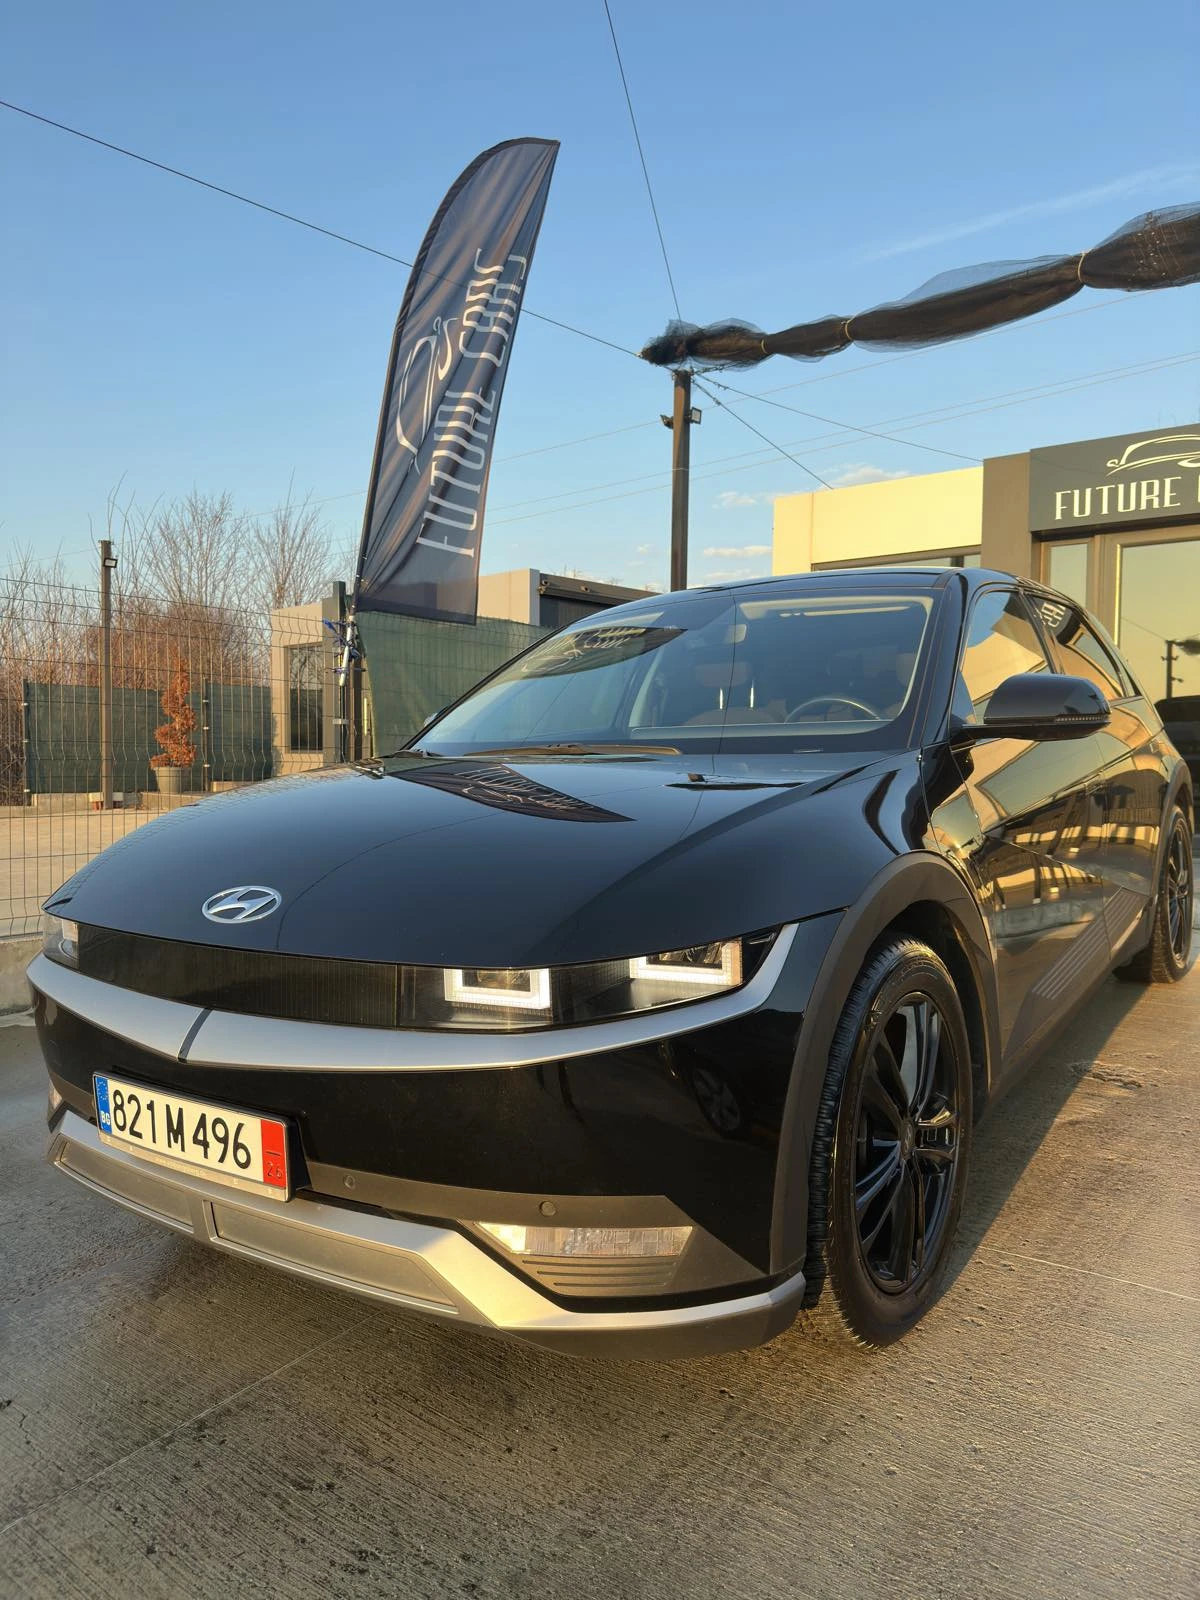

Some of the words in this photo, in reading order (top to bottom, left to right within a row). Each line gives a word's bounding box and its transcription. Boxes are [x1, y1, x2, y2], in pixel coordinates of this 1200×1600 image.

[416, 386, 496, 558] FUTURE
[459, 248, 526, 367] CARS
[1054, 476, 1182, 520] FUTURE
[100, 1110, 111, 1126] BG
